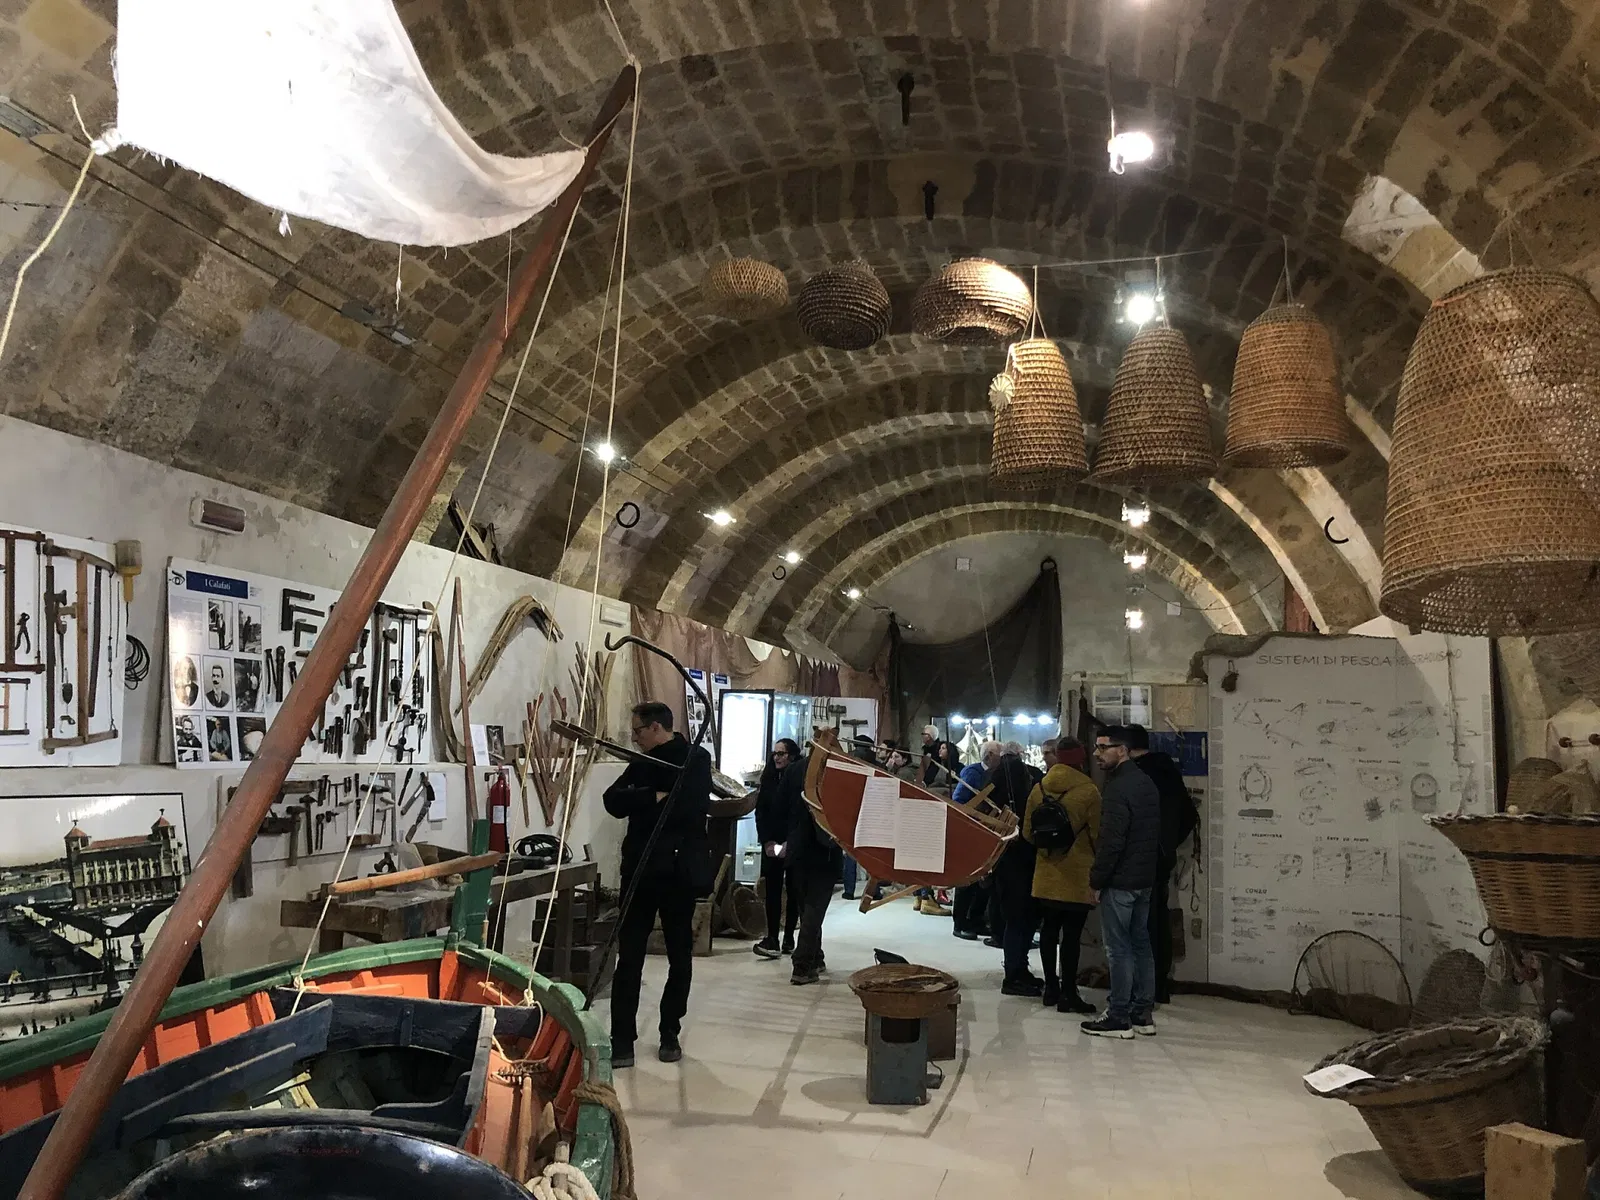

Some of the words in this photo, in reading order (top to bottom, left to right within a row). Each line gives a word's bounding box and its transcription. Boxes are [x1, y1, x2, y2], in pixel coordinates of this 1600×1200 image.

[209, 580, 231, 590] Calafati
[1256, 654, 1319, 665] SISTEMI
[1323, 655, 1337, 665] DI
[1341, 655, 1391, 666] PESCA
